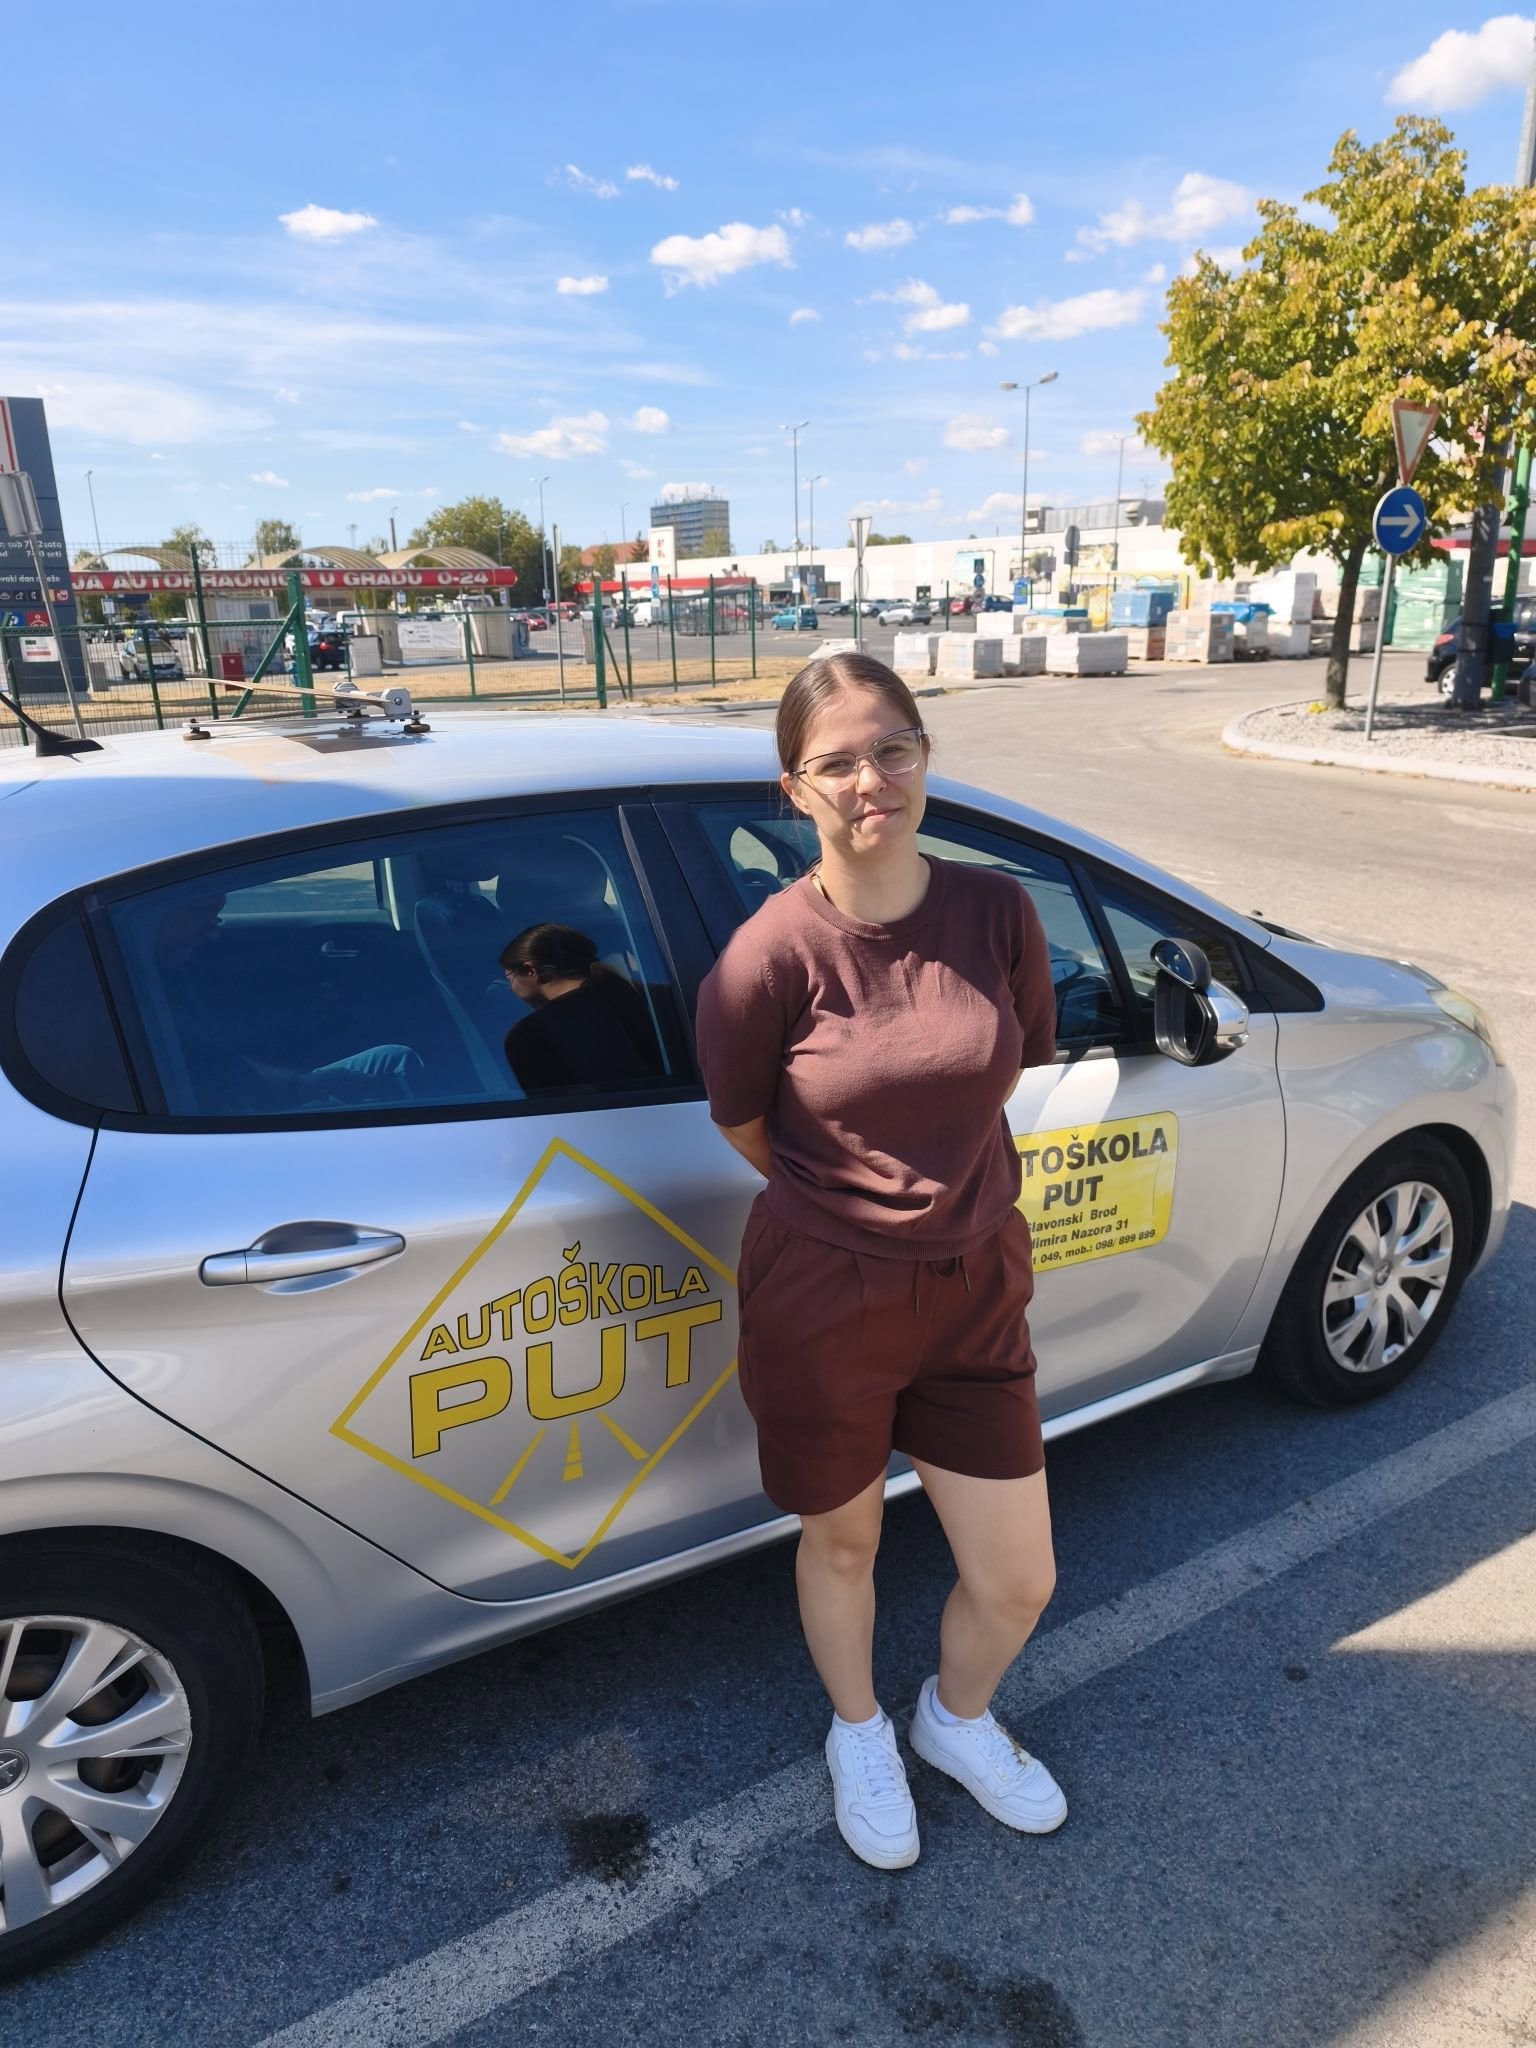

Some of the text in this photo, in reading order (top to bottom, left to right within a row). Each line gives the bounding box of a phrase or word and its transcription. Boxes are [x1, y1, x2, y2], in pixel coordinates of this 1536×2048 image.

[72, 574, 104, 590] JA
[319, 571, 336, 586] U
[343, 571, 422, 586] GRADU
[1020, 1127, 1168, 1177] TOŠKOLA
[1043, 1174, 1104, 1212] PUT
[1090, 1205, 1118, 1221] Brod
[1032, 1219, 1129, 1249] imira Nazora 31
[1040, 1252, 1062, 1263] 049,
[1065, 1245, 1093, 1258] mob.:
[420, 1240, 710, 1361] AUTOŠKOLA
[409, 1299, 722, 1459] PUT
